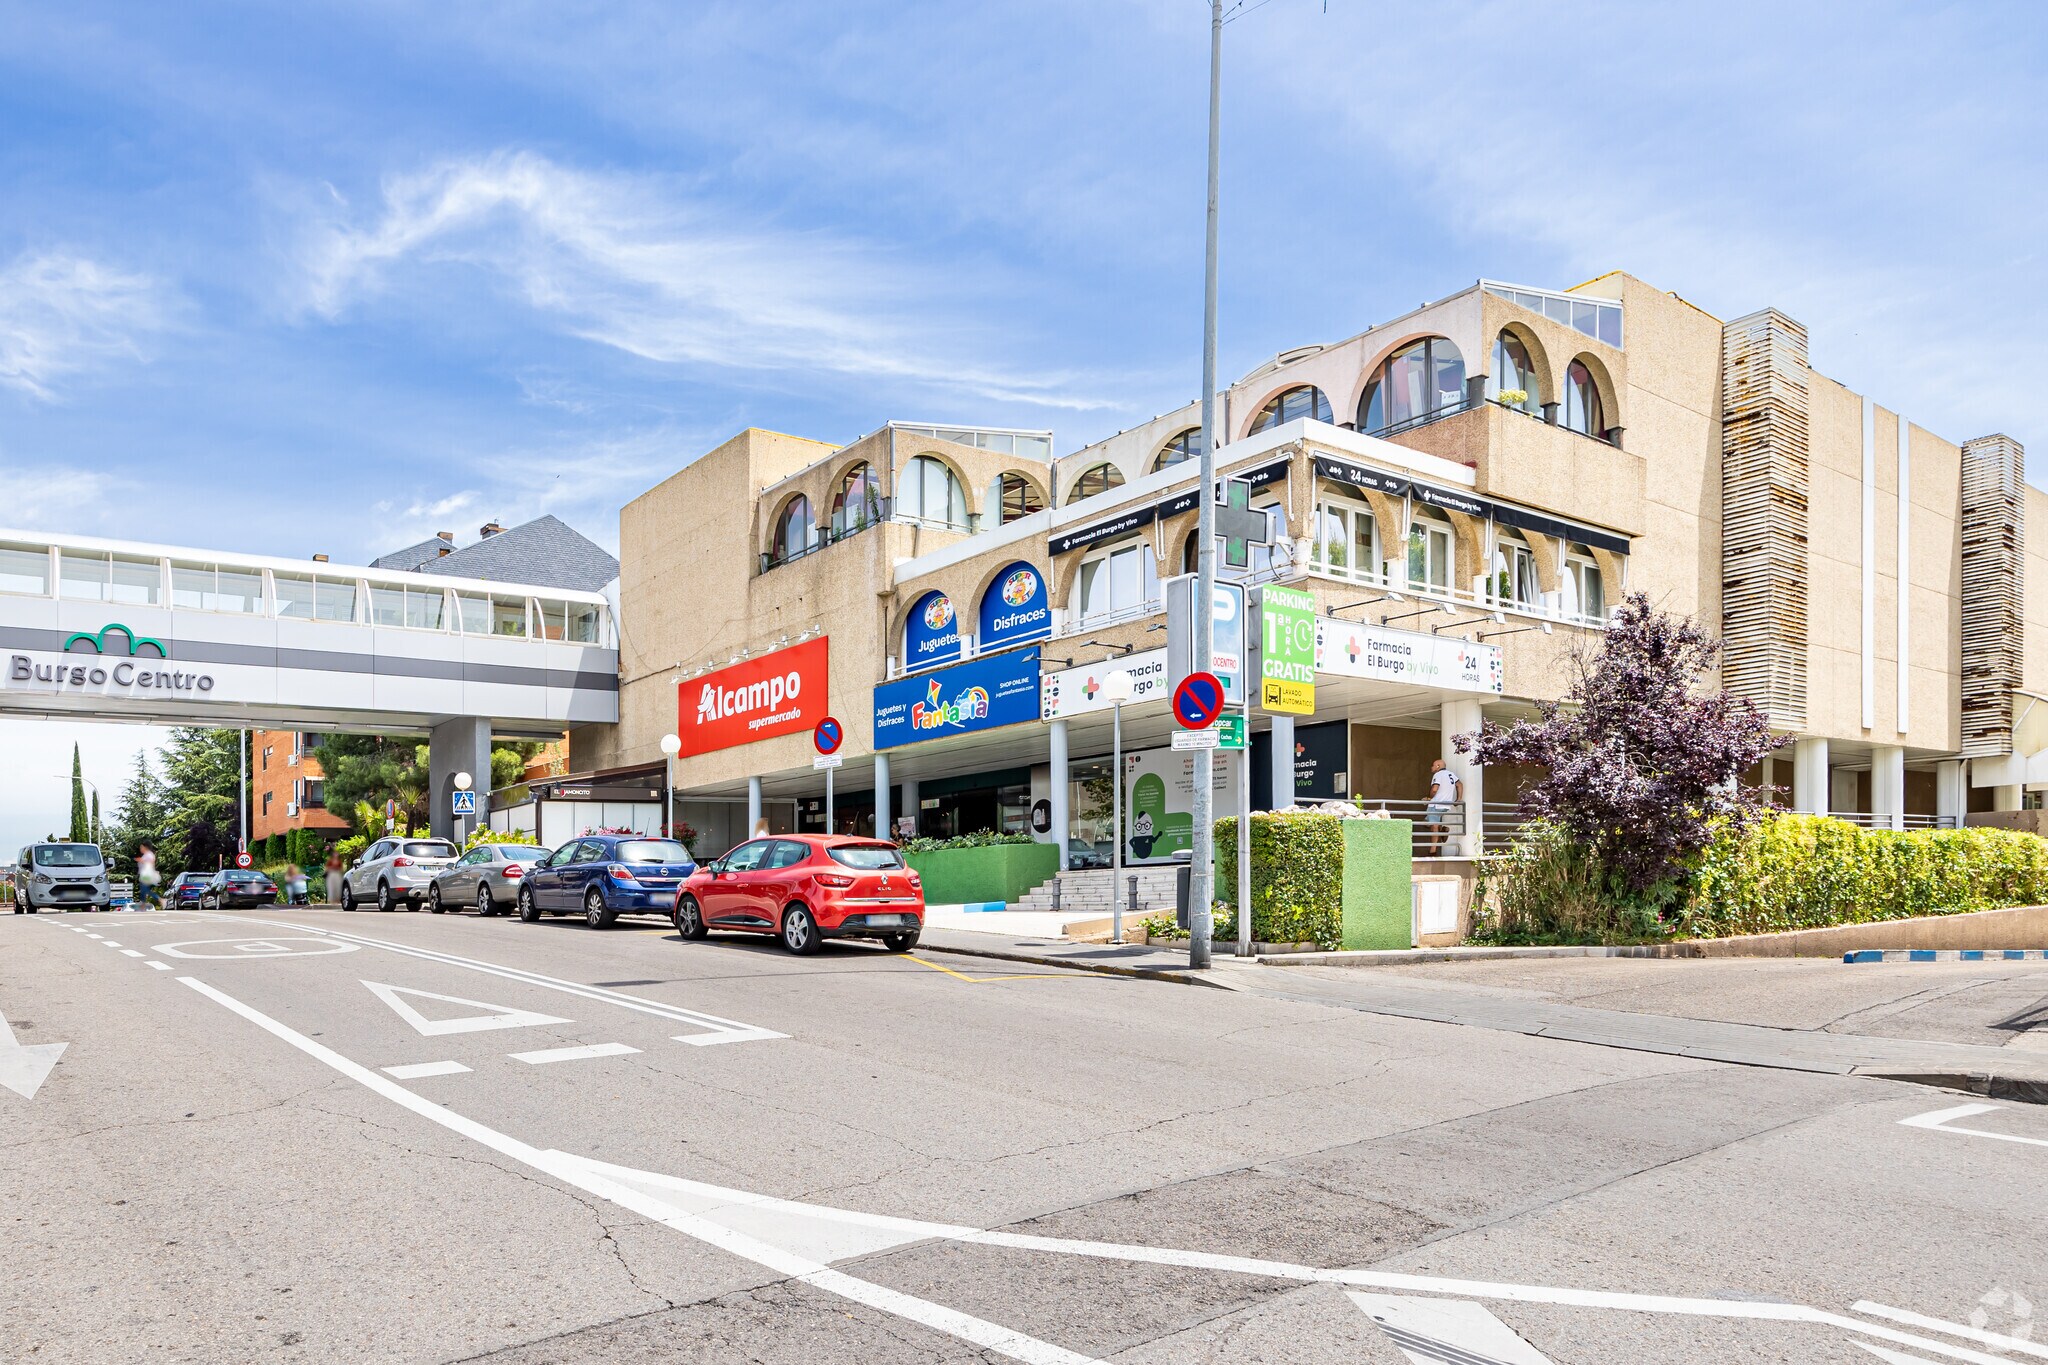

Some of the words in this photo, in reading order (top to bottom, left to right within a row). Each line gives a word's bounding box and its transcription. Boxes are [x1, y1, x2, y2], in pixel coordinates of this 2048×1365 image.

[1351, 469, 1361, 481] 24
[1361, 476, 1378, 486] HORAS
[1072, 531, 1096, 544] Farmacia
[1102, 525, 1118, 534] Burgo
[1118, 522, 1125, 530] by
[1126, 518, 1138, 526] Vivo
[1008, 572, 1032, 586] SUPER
[929, 598, 950, 611] SUPER
[1263, 588, 1314, 612] PARKING
[993, 608, 1046, 632] Disfraces
[1367, 638, 1412, 656] Farmacia
[1263, 658, 1314, 683] GRATIS
[1367, 655, 1375, 667] El
[1377, 656, 1405, 674] Burgo
[1406, 660, 1418, 675] by
[1420, 661, 1439, 675] Vivo
[1465, 656, 1476, 670] 24
[1000, 681, 1011, 689] SHOP
[1012, 677, 1029, 686] ONLINE
[1461, 672, 1480, 682] HORAS
[697, 671, 801, 725] Alcampo
[1282, 688, 1302, 697] LAVADO
[876, 705, 902, 717] Juguetes
[902, 703, 907, 712] y
[911, 698, 989, 731] Fantasia
[748, 706, 801, 731] supermercado
[877, 716, 905, 728] Disfraces
[1296, 779, 1313, 787] Vivo
[1448, 773, 1455, 785] 5
